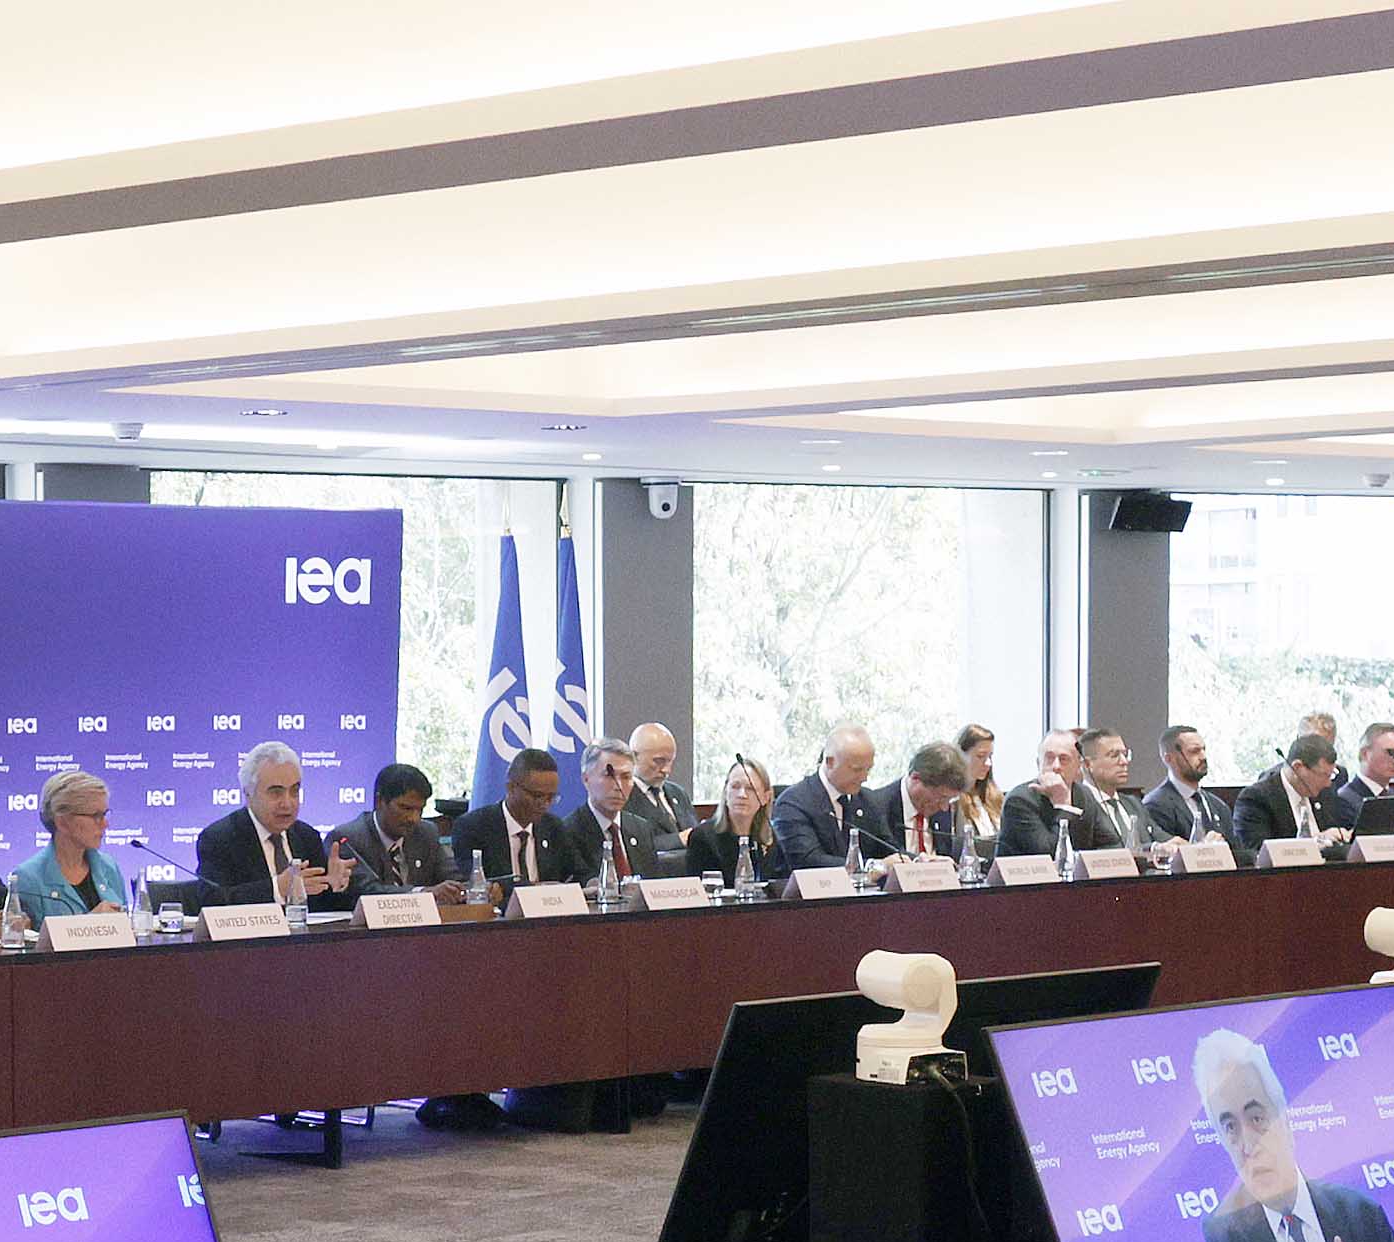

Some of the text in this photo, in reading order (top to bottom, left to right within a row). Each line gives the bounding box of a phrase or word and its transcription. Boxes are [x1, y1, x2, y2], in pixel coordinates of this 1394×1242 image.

[285, 556, 372, 605] iea
[377, 897, 420, 908] EXECUTIVE
[214, 914, 281, 928] UNITED STATES
[382, 913, 424, 925] DIRECTOR
[66, 925, 119, 938] INDONESIA
[1318, 1033, 1360, 1060] iea
[1131, 1056, 1177, 1085] iea
[1031, 1068, 1077, 1097] iea
[1091, 1127, 1145, 1144] International
[1195, 1133, 1221, 1144] Energ
[1097, 1142, 1160, 1159] Energy Agency
[1035, 1157, 1060, 1172] gency
[17, 1187, 89, 1228] iea
[1176, 1188, 1220, 1219] iea
[1077, 1204, 1124, 1236] iea
